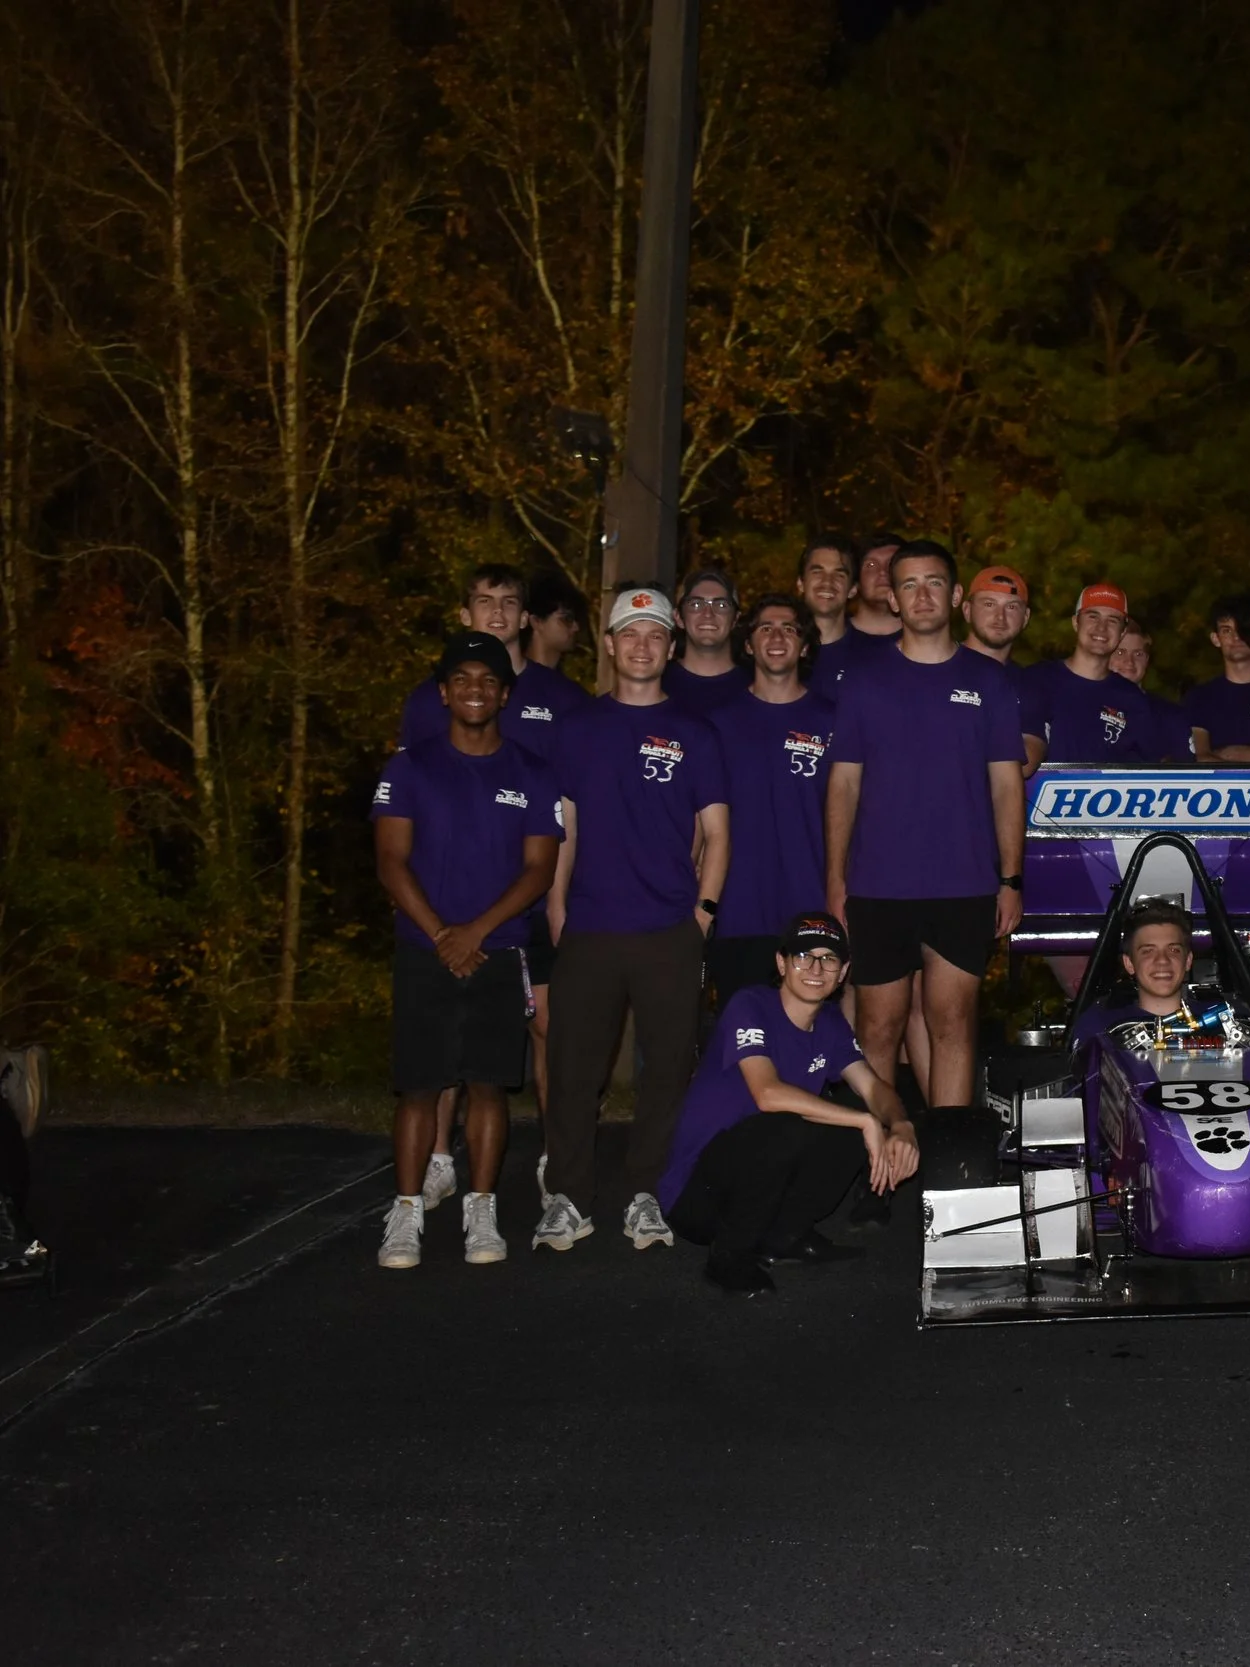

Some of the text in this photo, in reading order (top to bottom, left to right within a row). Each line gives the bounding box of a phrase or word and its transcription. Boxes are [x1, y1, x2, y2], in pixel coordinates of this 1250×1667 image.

[1103, 722, 1122, 744] 53
[640, 743, 684, 758] CLEMSON
[785, 738, 826, 753] CLEMSON
[643, 757, 675, 782] 53
[790, 752, 818, 778] 53
[736, 1028, 765, 1045] SAE
[1196, 1116, 1233, 1124] SAE
[961, 1295, 1103, 1309] AUTOMOTIVE ENGINEERING
